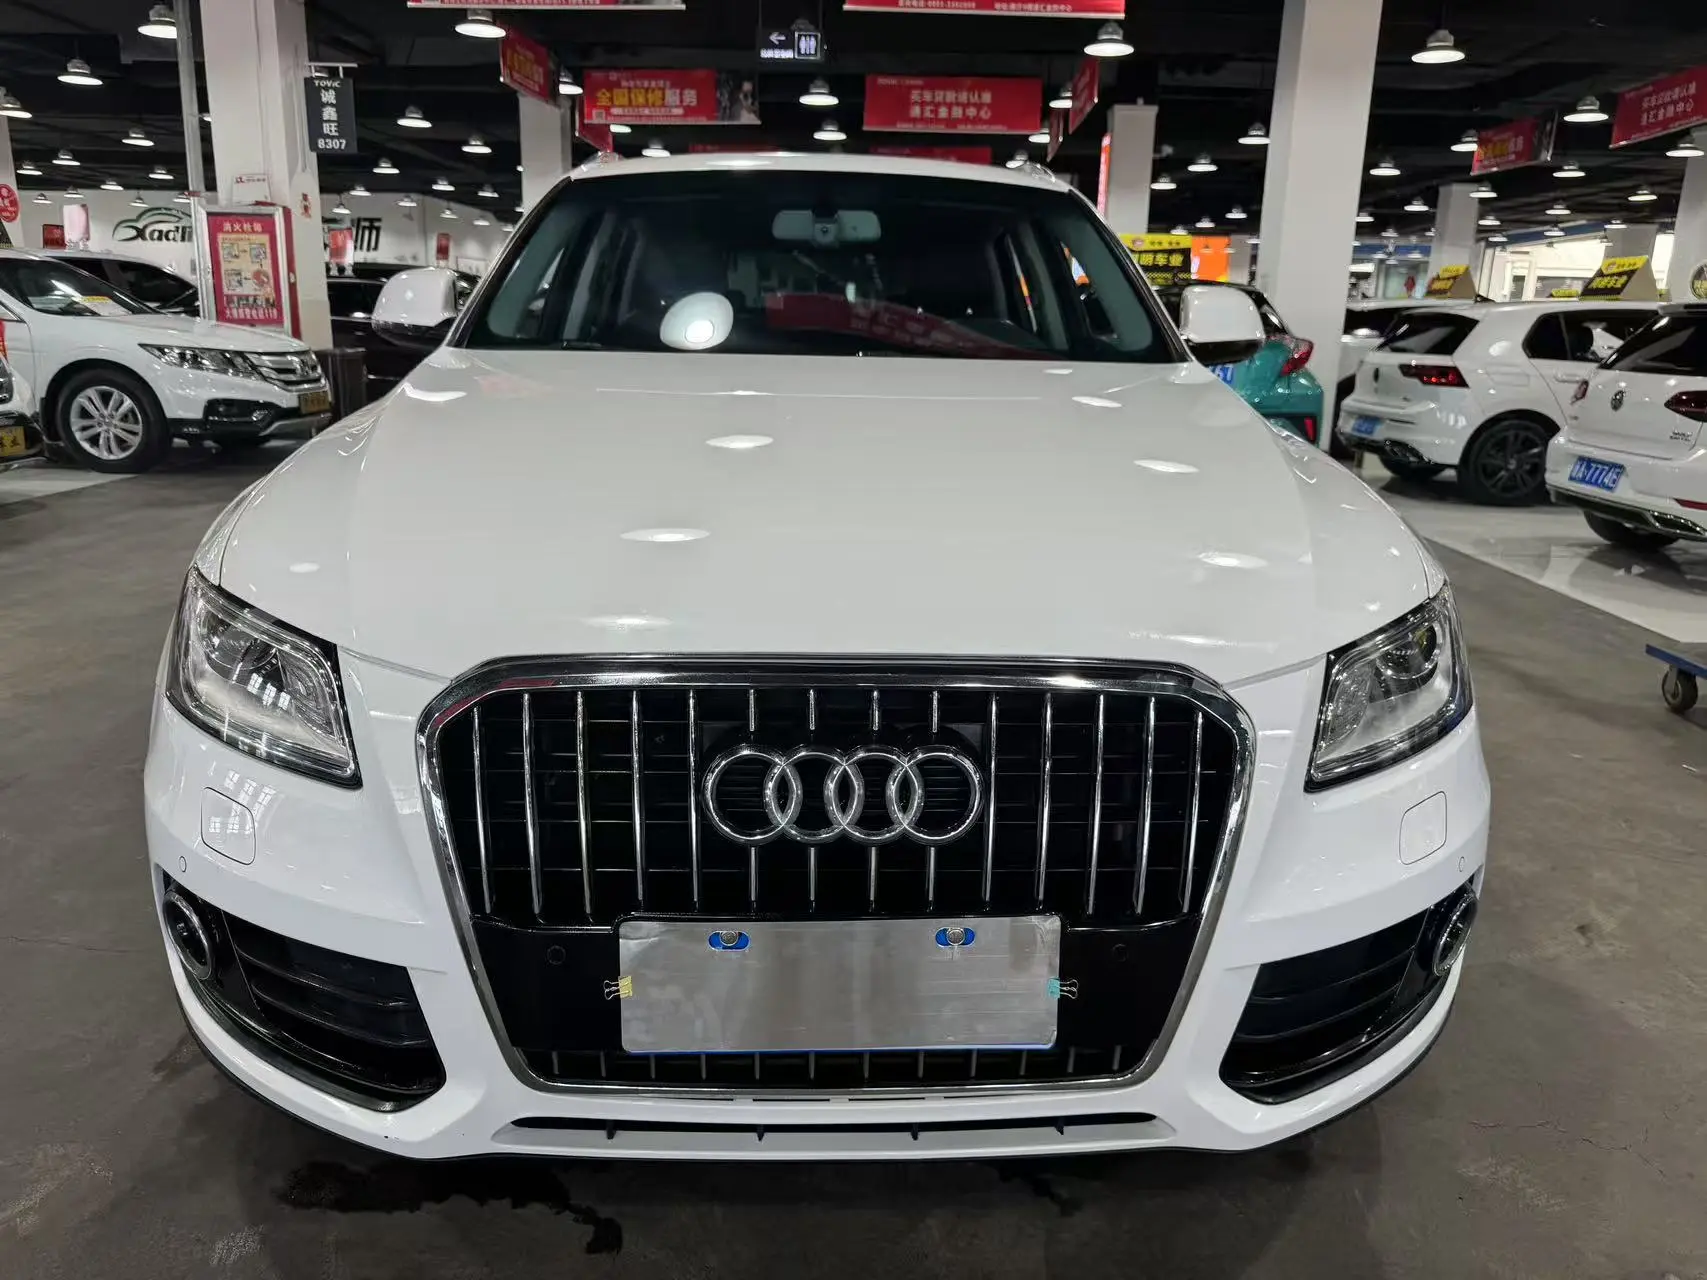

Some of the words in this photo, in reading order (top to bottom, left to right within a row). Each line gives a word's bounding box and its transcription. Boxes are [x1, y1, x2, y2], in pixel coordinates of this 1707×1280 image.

[596, 87, 698, 107] 全国保修服务
[317, 138, 346, 150] 8307
